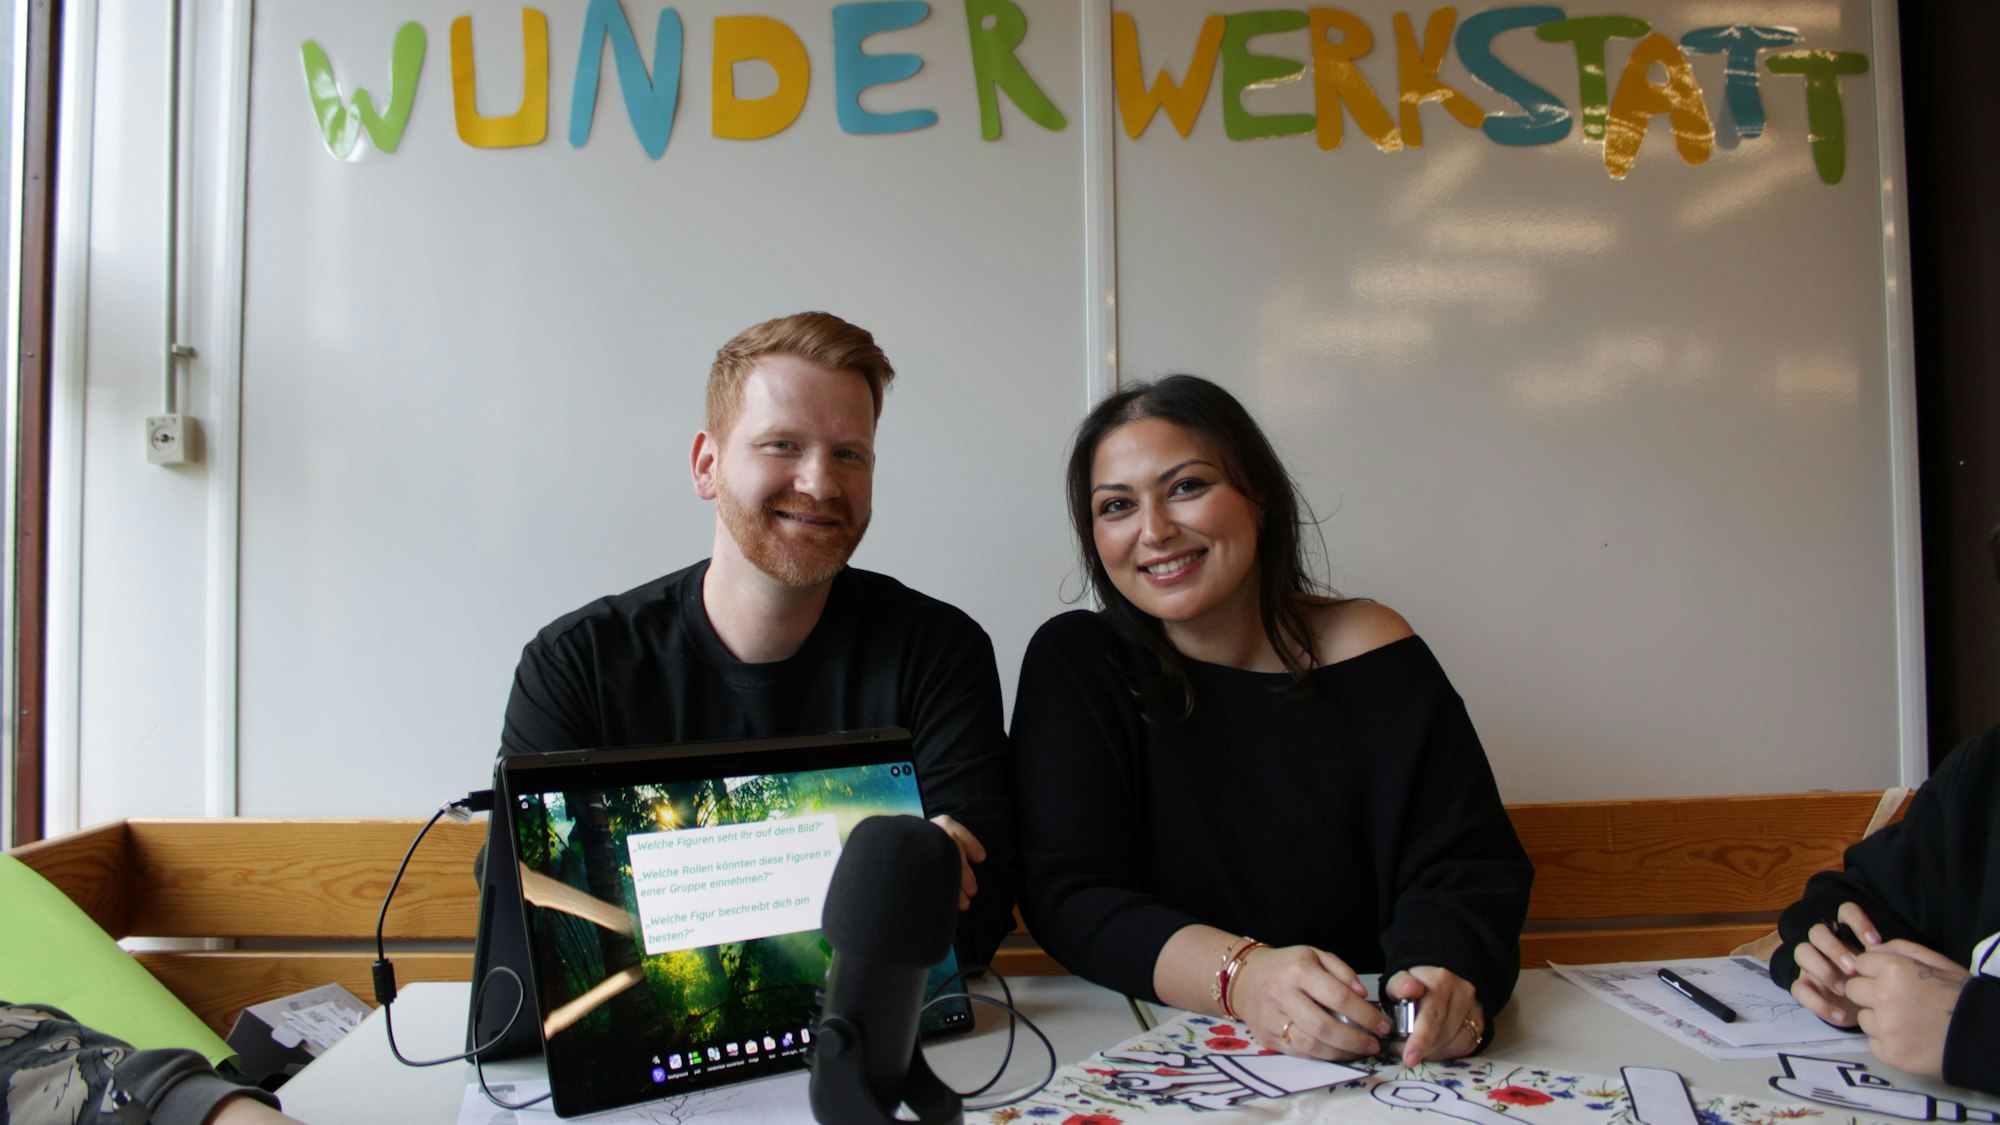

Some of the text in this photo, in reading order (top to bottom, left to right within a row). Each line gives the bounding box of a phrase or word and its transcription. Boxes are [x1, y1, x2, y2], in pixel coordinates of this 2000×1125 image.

[632, 840, 674, 853] „Welche
[677, 835, 714, 850] Figuren
[716, 832, 737, 843] seht
[740, 830, 753, 840] ihr
[755, 827, 772, 838] auf
[774, 825, 796, 836] dem
[638, 848, 831, 882] „Welche Rollen könnten diese Figuren in
[640, 885, 667, 898] einer
[670, 881, 707, 896] Gruppe
[646, 896, 810, 928] „Welche Figur beschreibt dich am
